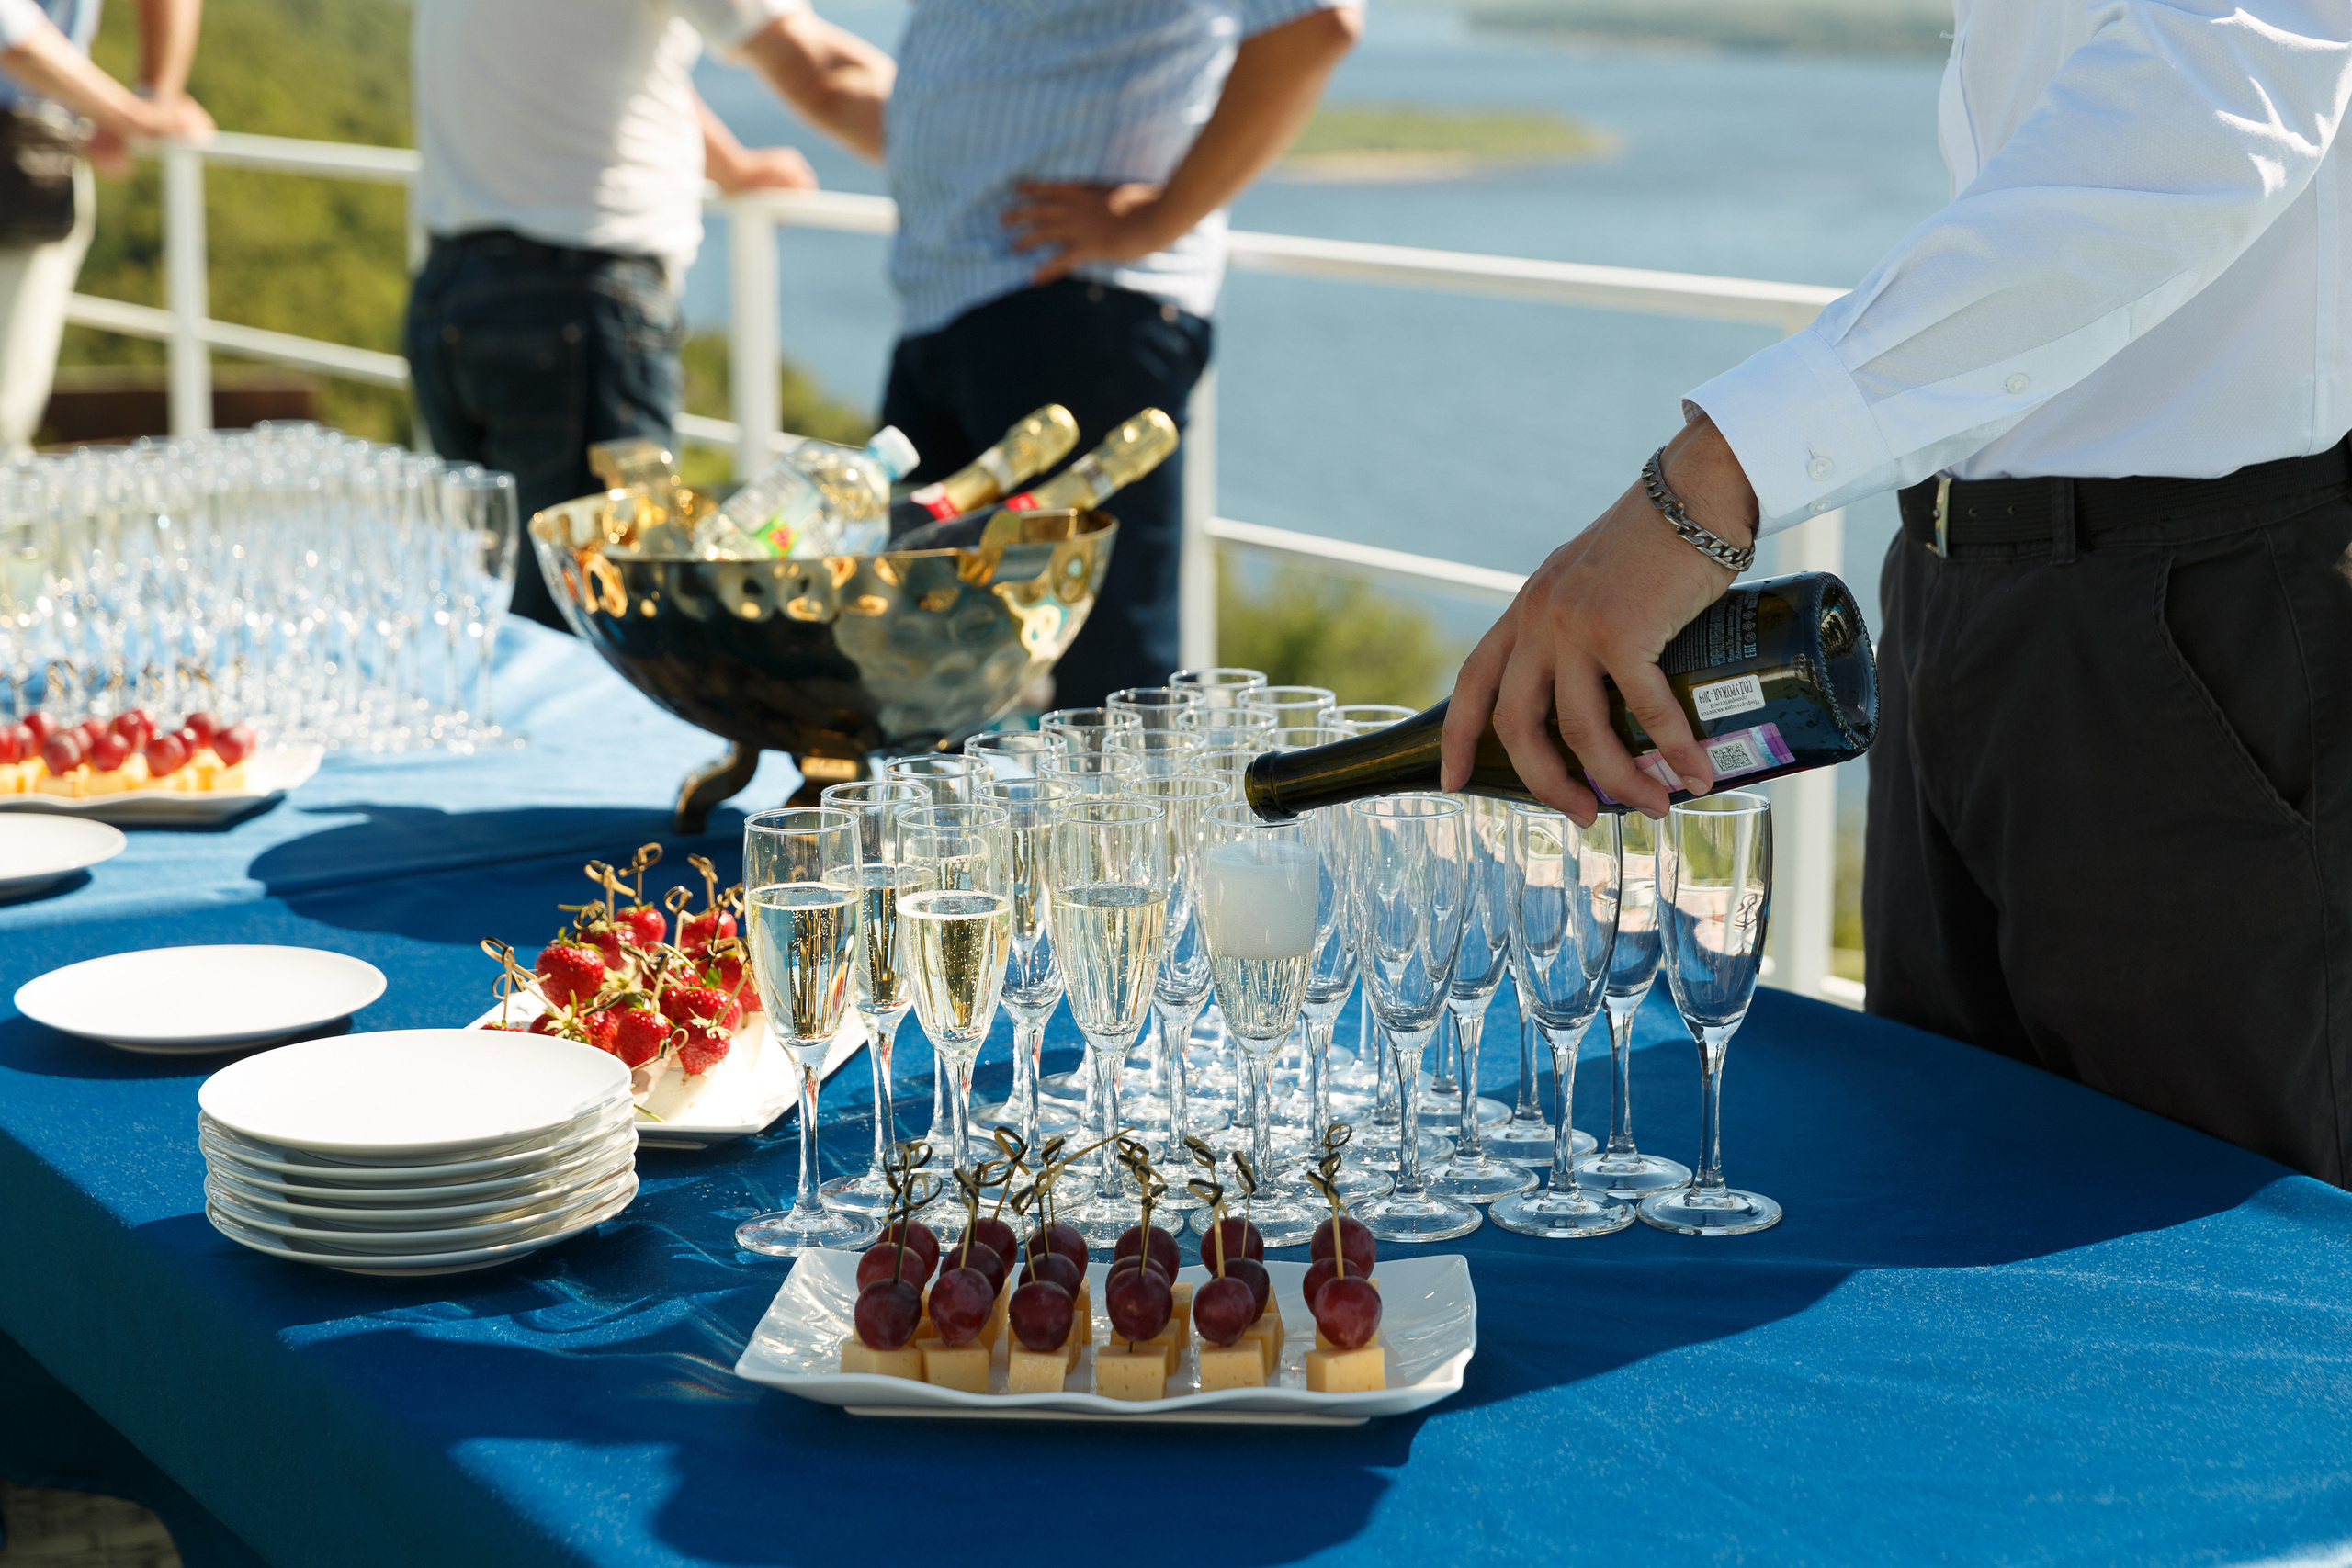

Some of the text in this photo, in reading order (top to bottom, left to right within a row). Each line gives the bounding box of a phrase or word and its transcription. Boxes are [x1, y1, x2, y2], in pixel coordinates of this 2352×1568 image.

[1713, 683, 1740, 700] УРОЖАЯ
[1738, 680, 1754, 694] ГОД
[1698, 691, 1712, 705] 2019
[1710, 695, 1748, 708] приоритетной
[1701, 699, 1760, 716] Информация является
